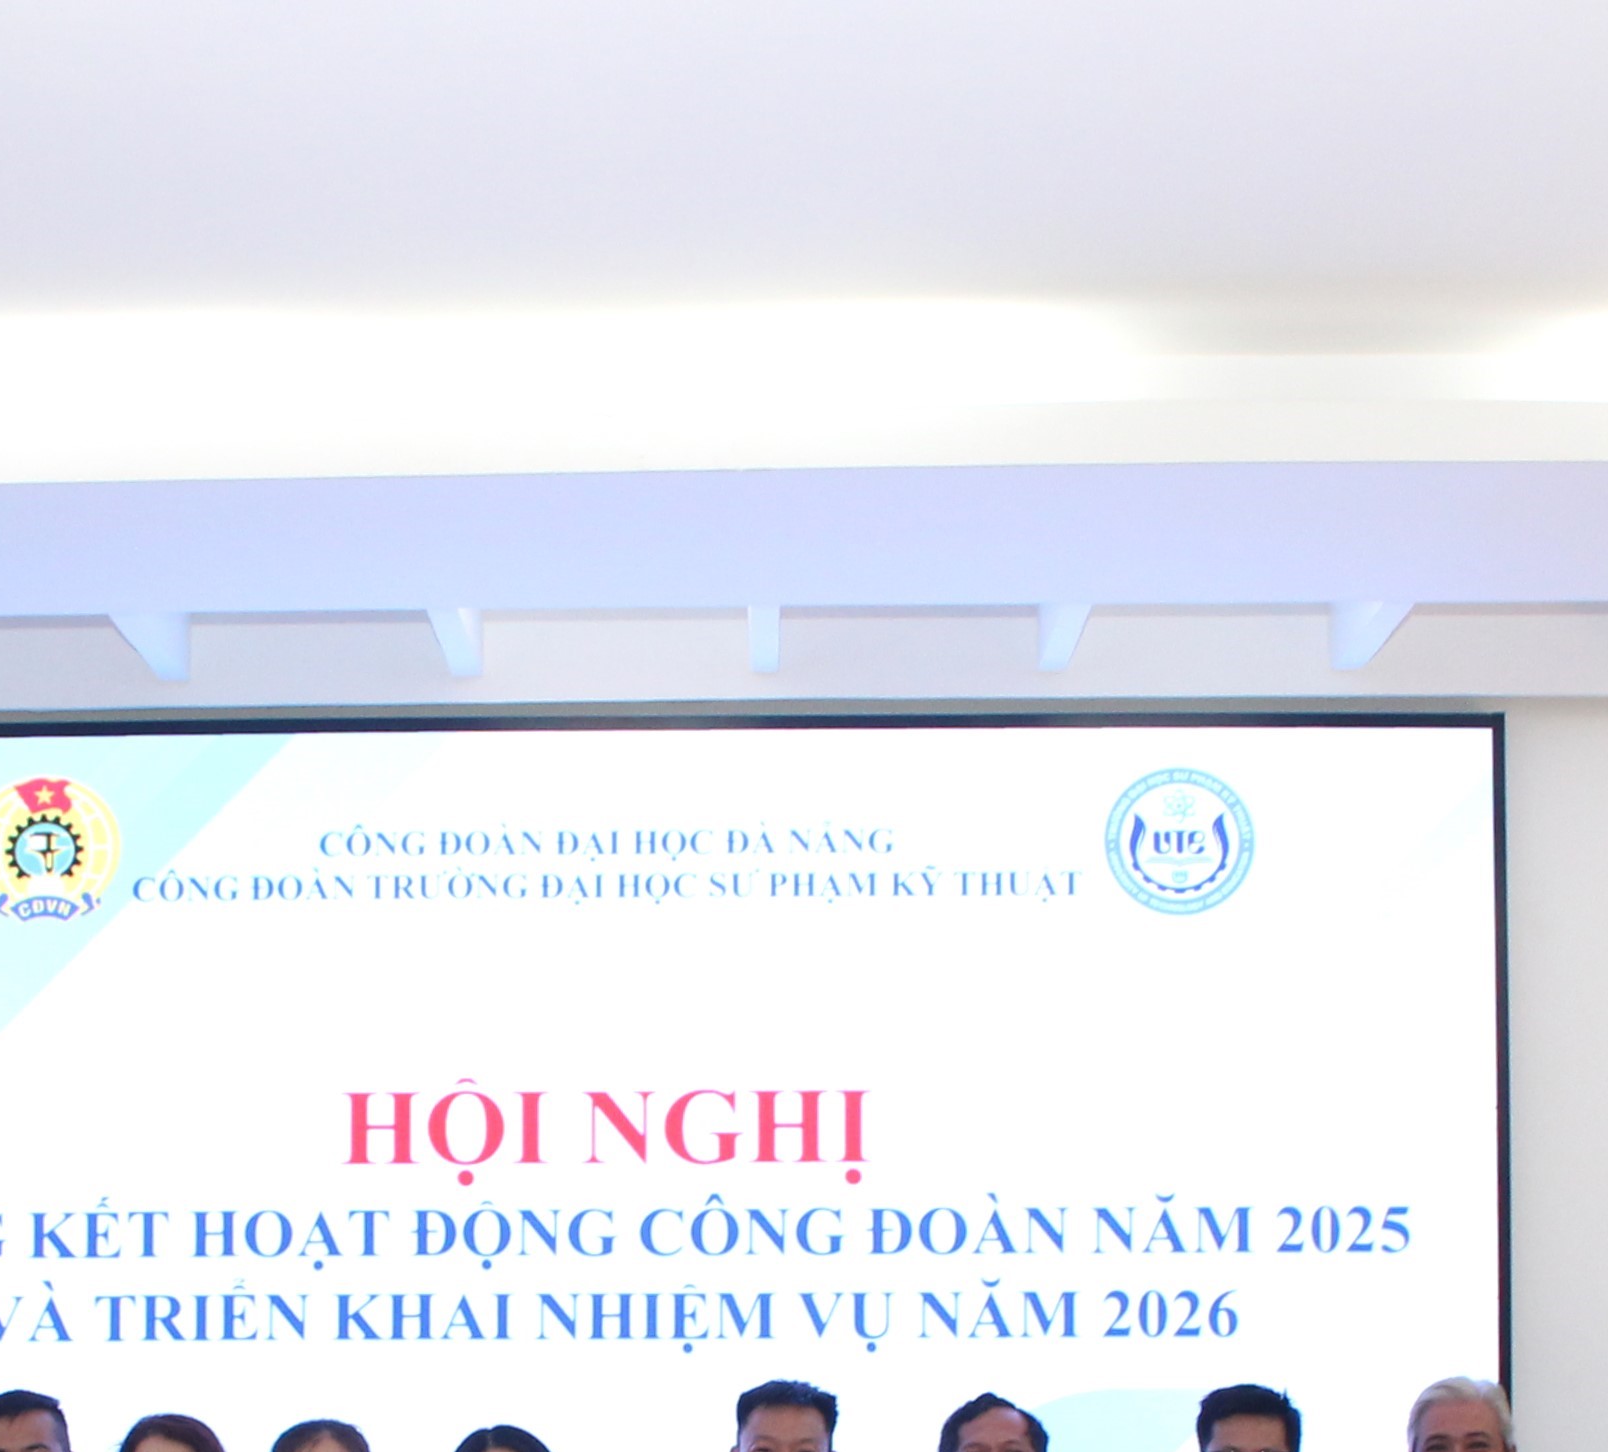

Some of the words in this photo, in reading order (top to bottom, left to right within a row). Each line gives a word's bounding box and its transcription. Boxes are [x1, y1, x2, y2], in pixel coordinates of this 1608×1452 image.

[319, 823, 425, 857] CÔNG
[439, 822, 542, 856] ĐOÀN
[557, 830, 619, 861] ĐẠI
[635, 829, 713, 861] HỌC
[726, 820, 775, 854] ĐÀ
[132, 868, 238, 902] CÔNG
[251, 866, 355, 901] ĐOÀN
[366, 866, 527, 900] TRƯỜNG
[542, 873, 604, 905] ĐẠI
[618, 872, 696, 904] HỌC
[709, 868, 760, 898] SƯ
[770, 871, 877, 903] PHẠM
[891, 865, 942, 897] KỸ
[953, 868, 1083, 903] THUẬT
[342, 1077, 549, 1186] HỘI
[583, 1088, 871, 1185] NGHỊ
[28, 1196, 170, 1259] KẾT
[191, 1209, 390, 1271] HOẠT
[410, 1199, 617, 1271] ĐỘNG
[638, 1193, 845, 1257] CÔNG
[867, 1192, 1068, 1256] ĐOÀN
[1092, 1193, 1253, 1255] NĂM
[1276, 1205, 1412, 1255] 2025
[94, 1277, 309, 1342] TRIỂN
[335, 1292, 514, 1341] KHAI
[535, 1283, 777, 1354] NHIỆM
[798, 1291, 894, 1353] VỤ
[917, 1277, 1080, 1339] NĂM
[1102, 1288, 1239, 1338] 2026
